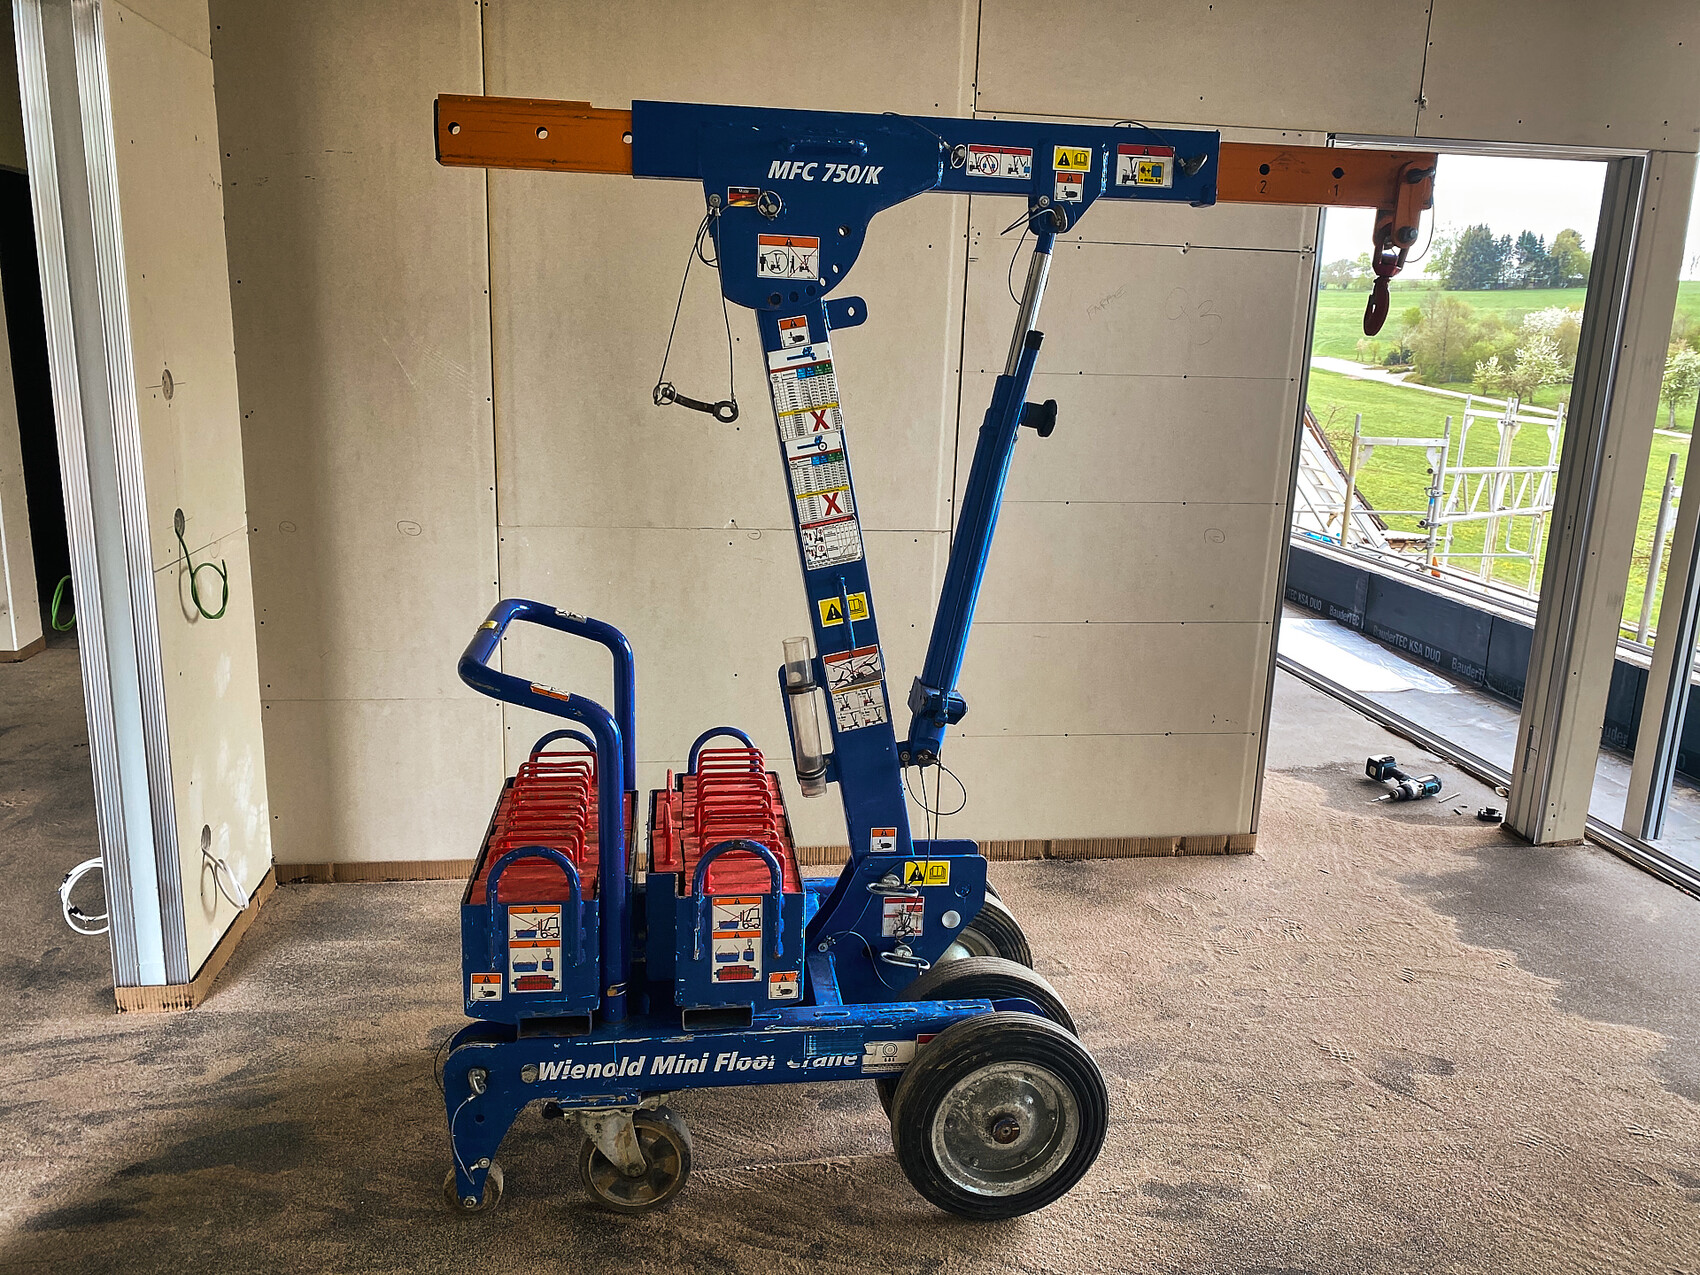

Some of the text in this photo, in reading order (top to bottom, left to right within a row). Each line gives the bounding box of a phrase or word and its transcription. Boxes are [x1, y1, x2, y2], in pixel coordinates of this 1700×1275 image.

[767, 160, 884, 185] MFC 750/K
[1259, 180, 1267, 194] 2
[1334, 184, 1339, 197] 1
[1297, 591, 1309, 606] KSA
[1309, 597, 1322, 611] DUO
[1408, 639, 1423, 656] KSA
[1424, 645, 1441, 663] DUO
[538, 1055, 646, 1082] Wienold
[650, 1052, 710, 1076] Mini
